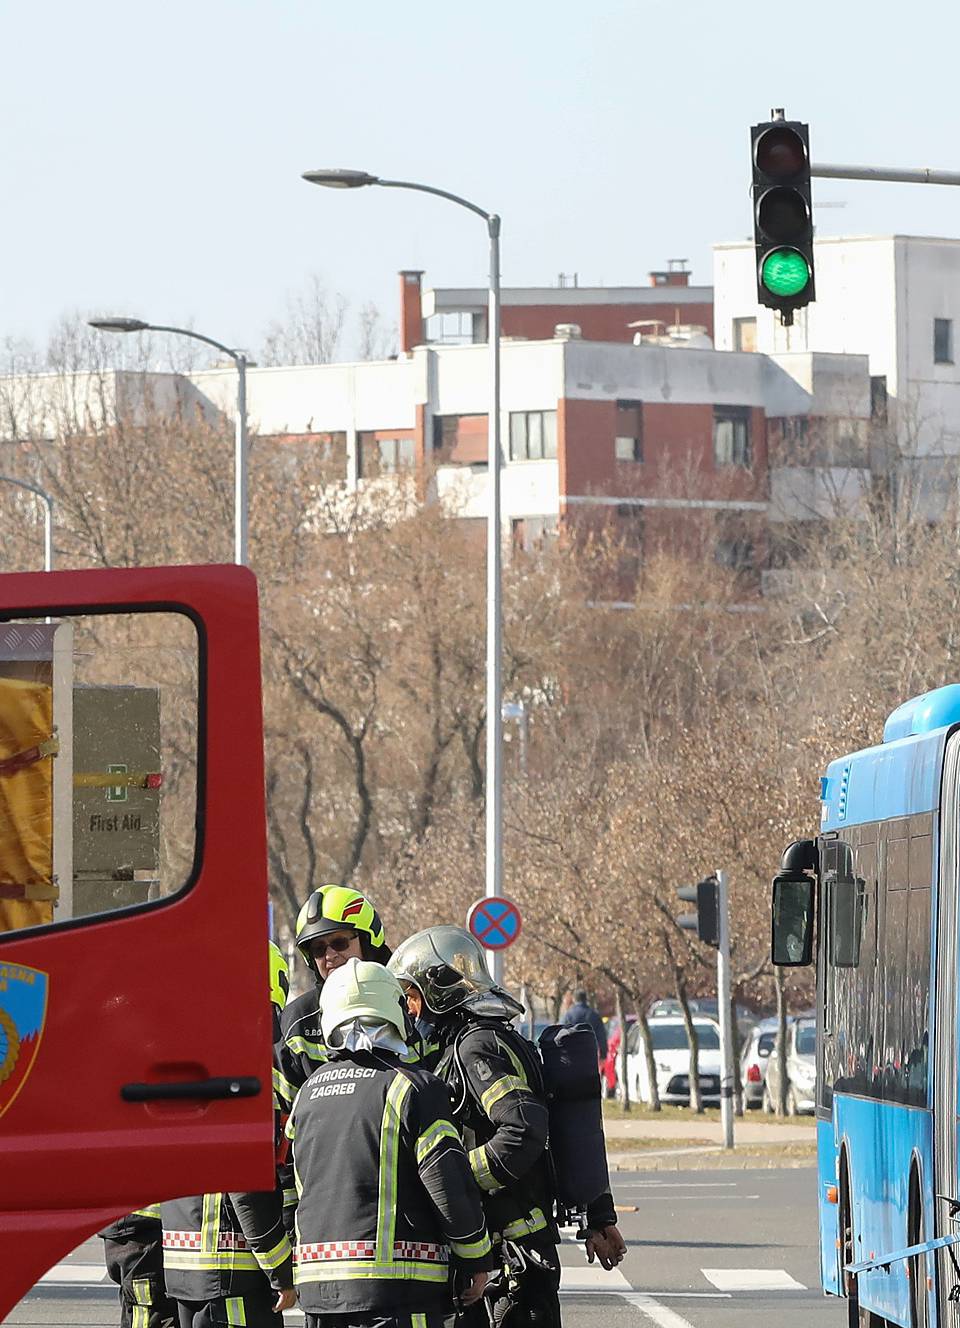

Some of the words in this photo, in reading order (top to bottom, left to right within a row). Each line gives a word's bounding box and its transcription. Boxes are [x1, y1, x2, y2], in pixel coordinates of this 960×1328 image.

[89, 814, 118, 832] First
[121, 814, 142, 831] Aid
[309, 1082, 357, 1101] ZAGREB
